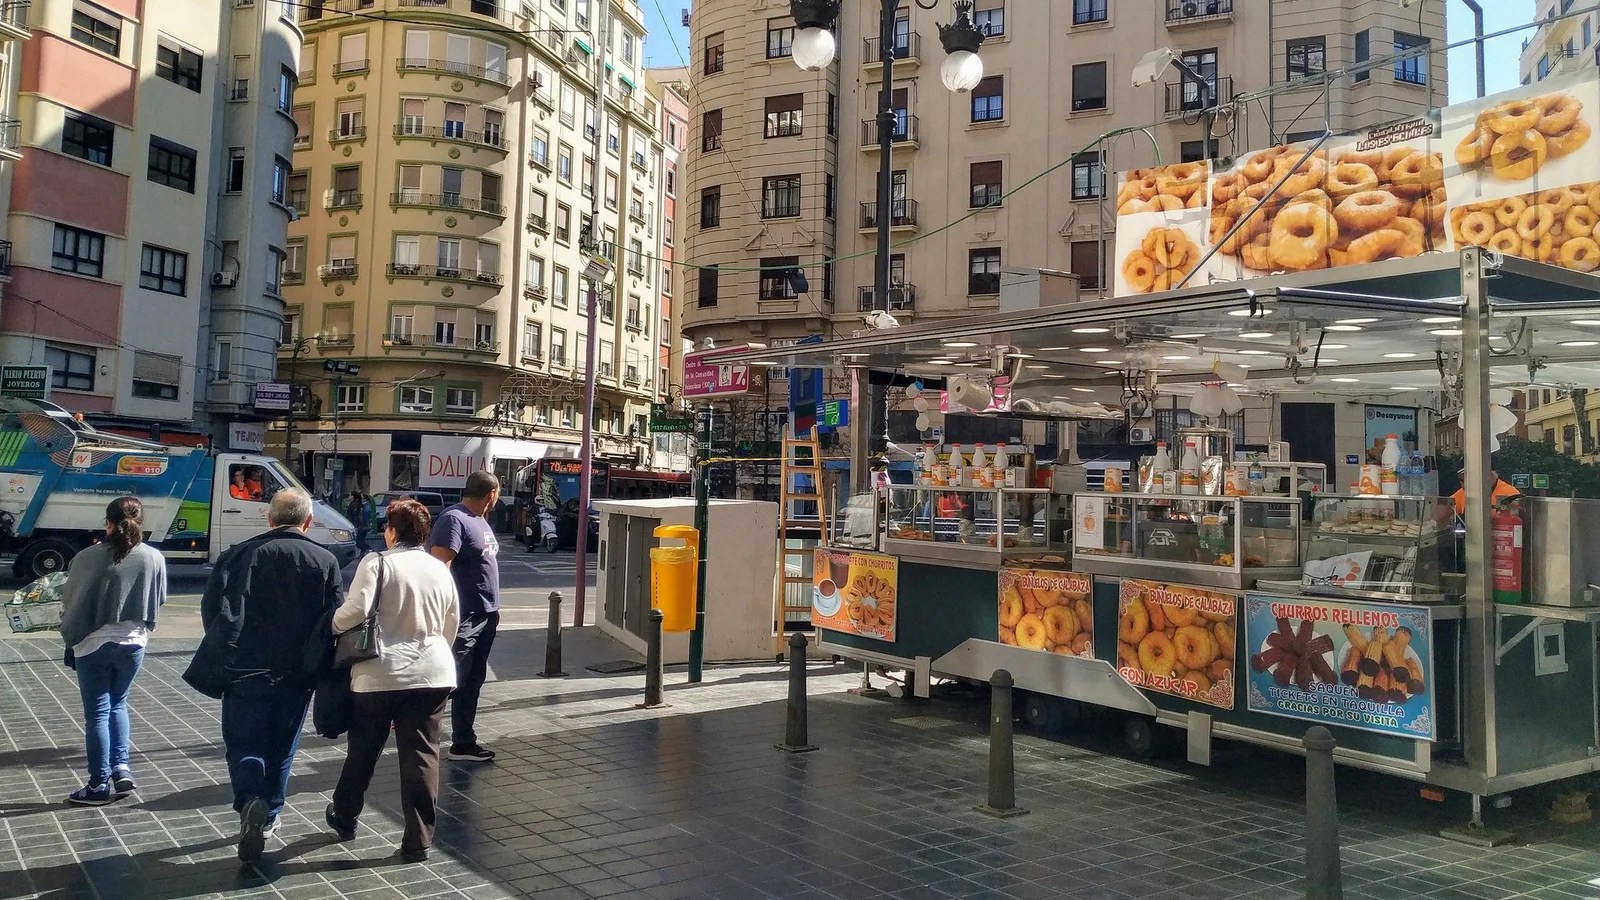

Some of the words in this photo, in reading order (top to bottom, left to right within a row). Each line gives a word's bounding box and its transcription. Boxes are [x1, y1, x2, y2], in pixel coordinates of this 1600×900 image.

[1356, 140, 1377, 151] LOS
[4, 369, 22, 379] MARIO
[23, 369, 46, 380] PUERTO
[6, 380, 40, 388] JOYEROS
[1376, 410, 1413, 421] Desayunos
[550, 461, 561, 472] 70
[858, 557, 868, 568] CON
[868, 559, 895, 572] CHURRITOS
[1049, 579, 1058, 591] DE
[1058, 578, 1091, 594] CALABAZA
[1149, 586, 1183, 607] BUÑUELOS
[1183, 595, 1195, 609] DE
[1195, 596, 1235, 616] CALABAZA
[1270, 602, 1329, 622] CHURROS
[1331, 607, 1400, 629] RELLENOS
[1118, 666, 1146, 685] CON
[1146, 670, 1199, 697] AZUCAR
[1308, 681, 1360, 699] SAQUEN
[1268, 686, 1319, 704] TICKETS
[1321, 694, 1339, 708] EN
[1340, 697, 1406, 718] TAQUILLA
[1276, 699, 1320, 715] GRACIAS
[1321, 706, 1345, 719] POR
[1345, 710, 1361, 722] SU
[1361, 713, 1399, 728] VISITA
